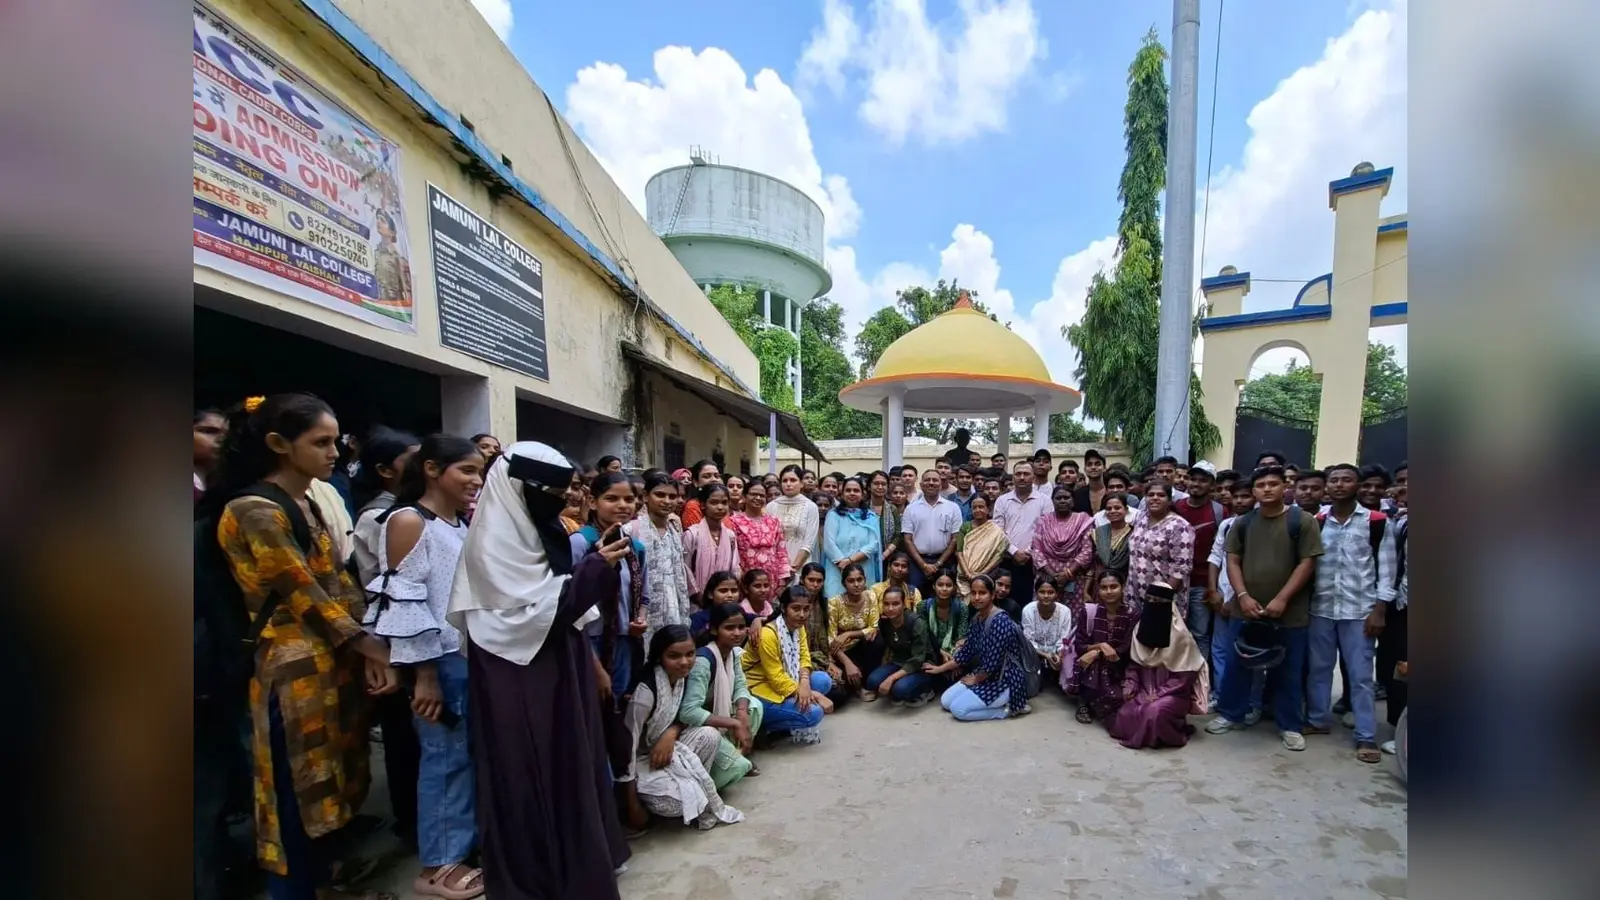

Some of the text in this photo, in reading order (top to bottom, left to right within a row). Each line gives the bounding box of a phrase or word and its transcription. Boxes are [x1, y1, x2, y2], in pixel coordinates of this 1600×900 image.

[238, 85, 278, 115] CADET
[280, 112, 313, 139] CORPS
[237, 104, 359, 192] ADMISSION
[217, 213, 287, 251] JAMUNI
[291, 243, 318, 264] LAL
[320, 255, 372, 288] COLLEGE
[308, 231, 368, 267] 9102250740
[432, 193, 480, 236] JAMUNI
[482, 224, 502, 250] LAL
[503, 239, 542, 277] COLLEGE
[295, 258, 341, 285] VAISHALI
